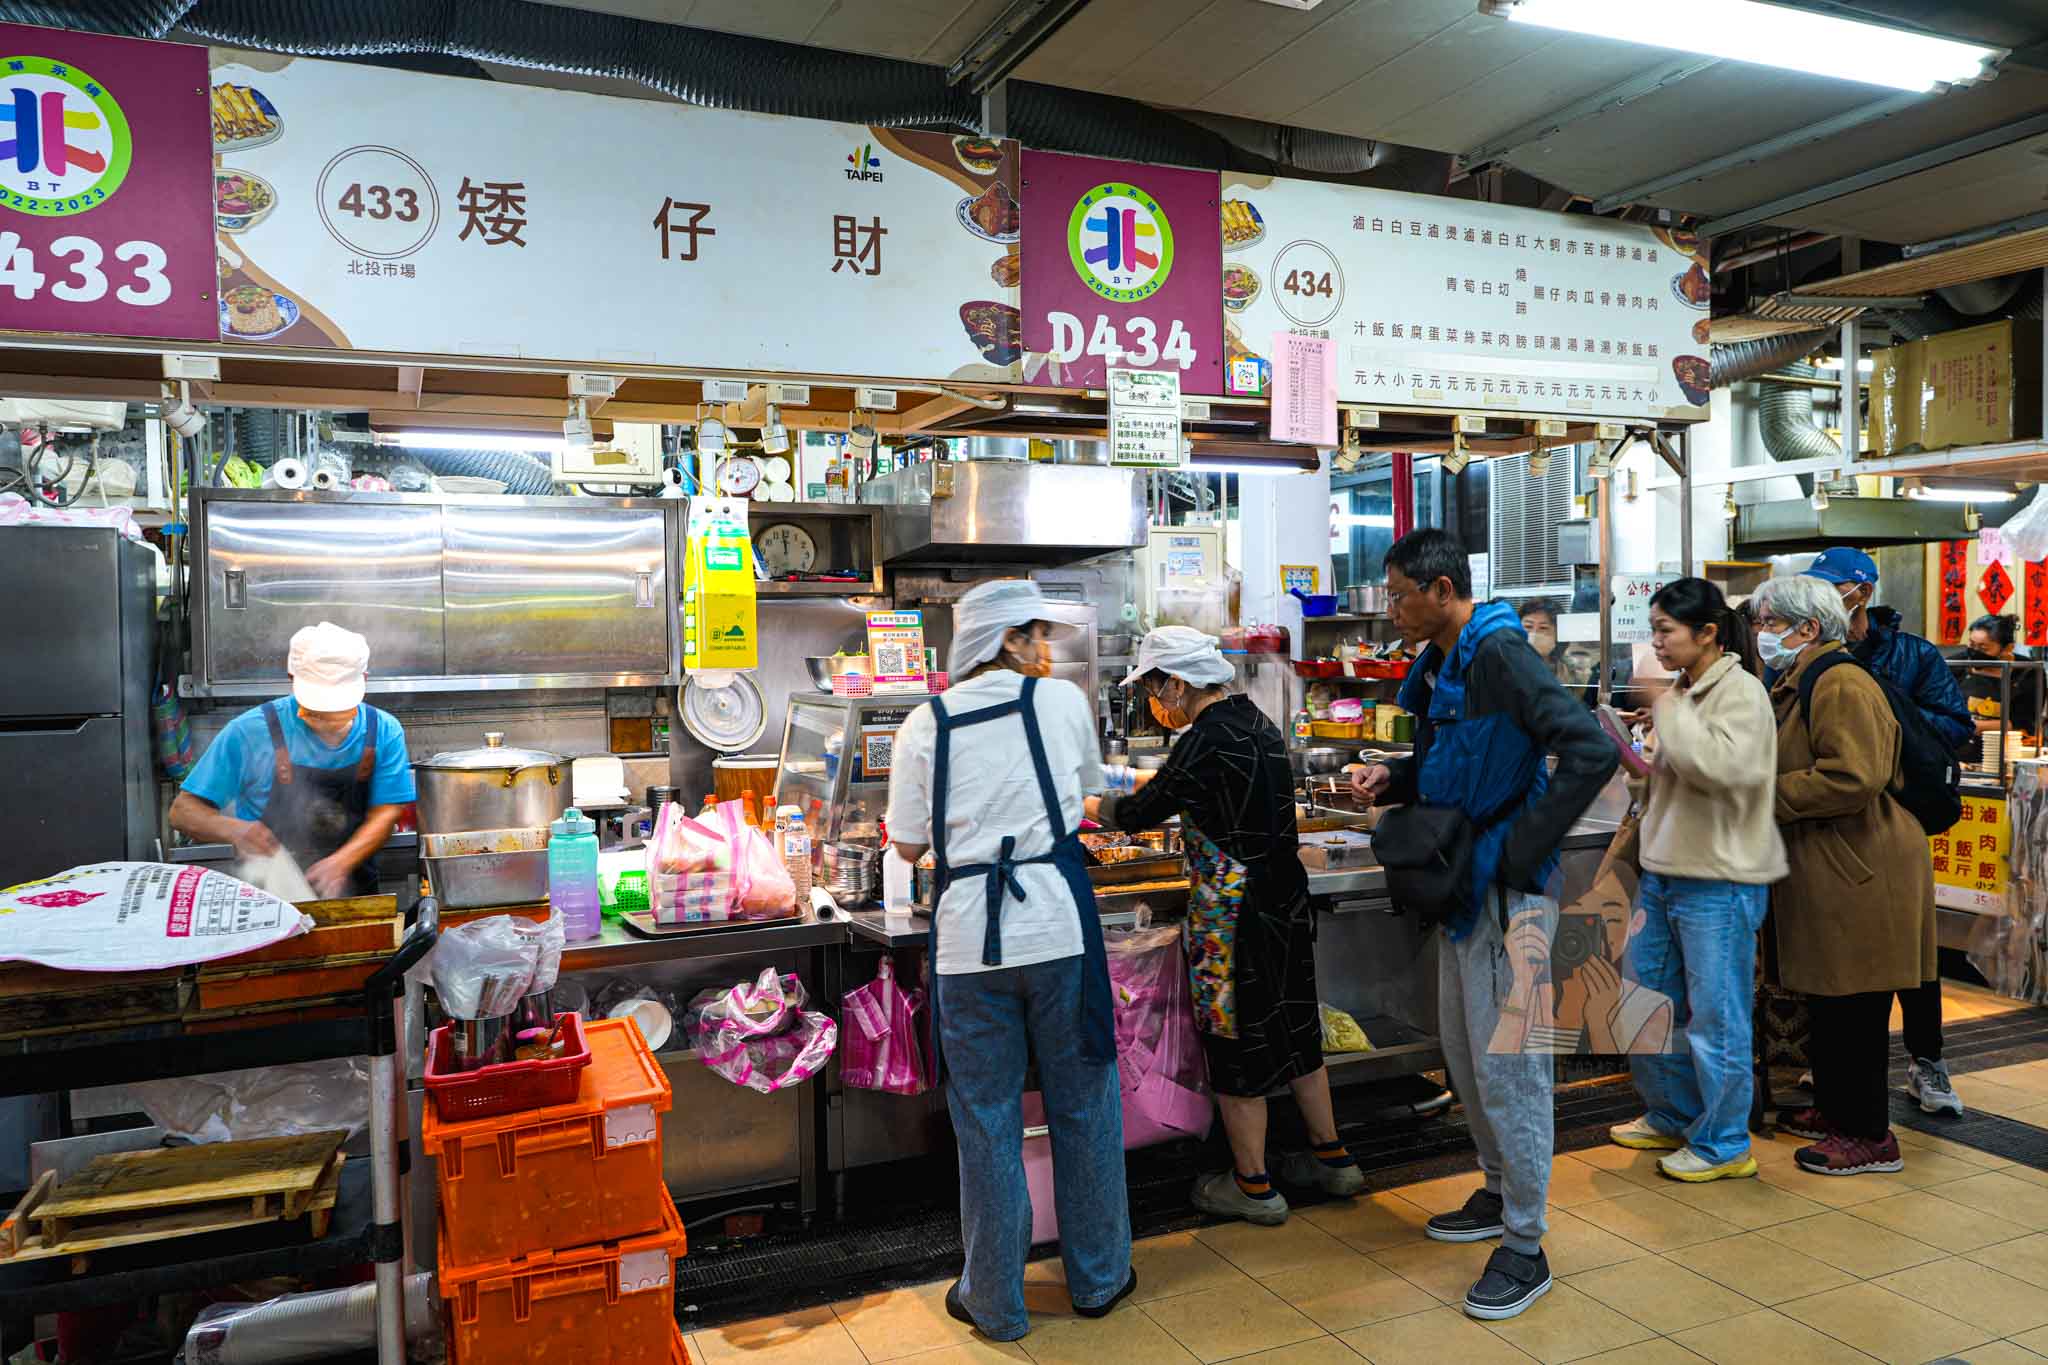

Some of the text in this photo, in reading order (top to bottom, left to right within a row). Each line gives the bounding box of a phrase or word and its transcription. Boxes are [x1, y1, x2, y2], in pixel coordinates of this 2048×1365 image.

[845, 168, 883, 183] TAIPEI
[338, 183, 420, 222] 433
[347, 260, 416, 279] 北投市場
[1284, 269, 1333, 298] 434
[1087, 277, 1159, 299] 2022-2023
[1048, 311, 1197, 369] D434
[1933, 831, 1951, 873] 肉飯
[1979, 806, 1997, 881] 滷肉飯
